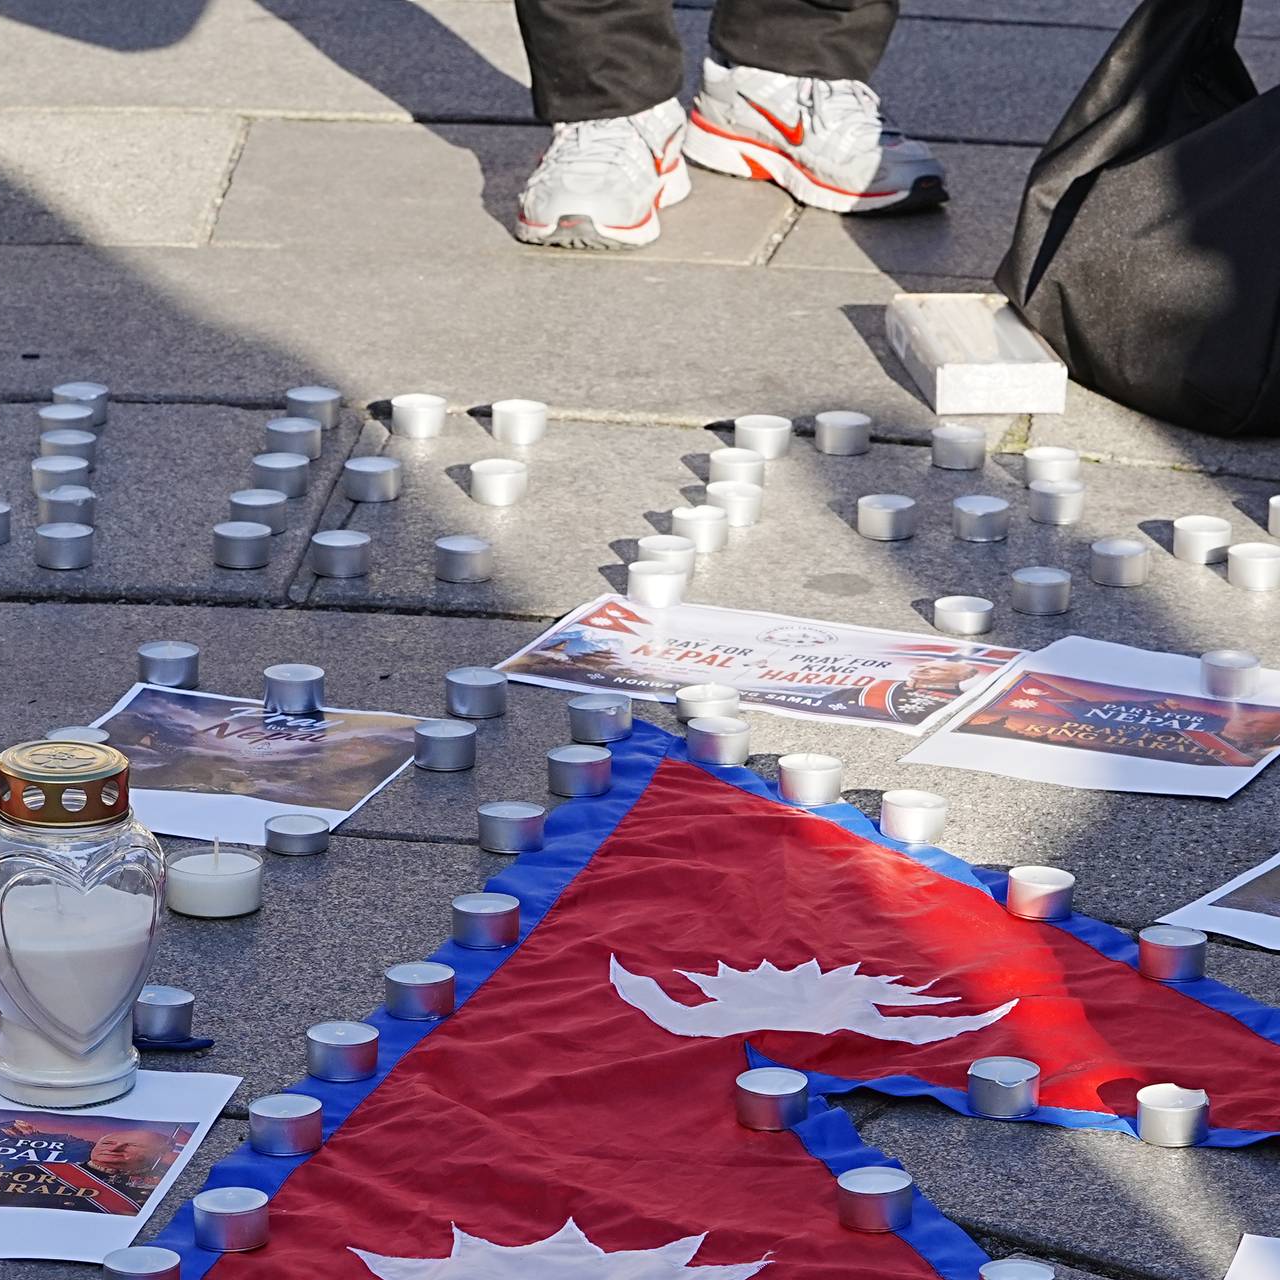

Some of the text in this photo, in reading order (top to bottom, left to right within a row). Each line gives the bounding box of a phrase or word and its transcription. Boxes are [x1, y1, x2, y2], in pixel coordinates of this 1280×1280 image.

[630, 644, 736, 668] NEPAL
[710, 644, 754, 657] FOR
[788, 654, 892, 668] PRAY FOR
[799, 663, 859, 674] KING
[758, 669, 877, 687] HARALD
[764, 690, 823, 707] SAMAJ
[223, 706, 345, 732] Pray
[1084, 707, 1206, 732] NEPAL
[1102, 703, 1205, 723] PARY FOR
[1024, 723, 1227, 757] KING HARALD
[1063, 721, 1192, 746] PRAY FOR
[15, 1138, 66, 1151] FOR
